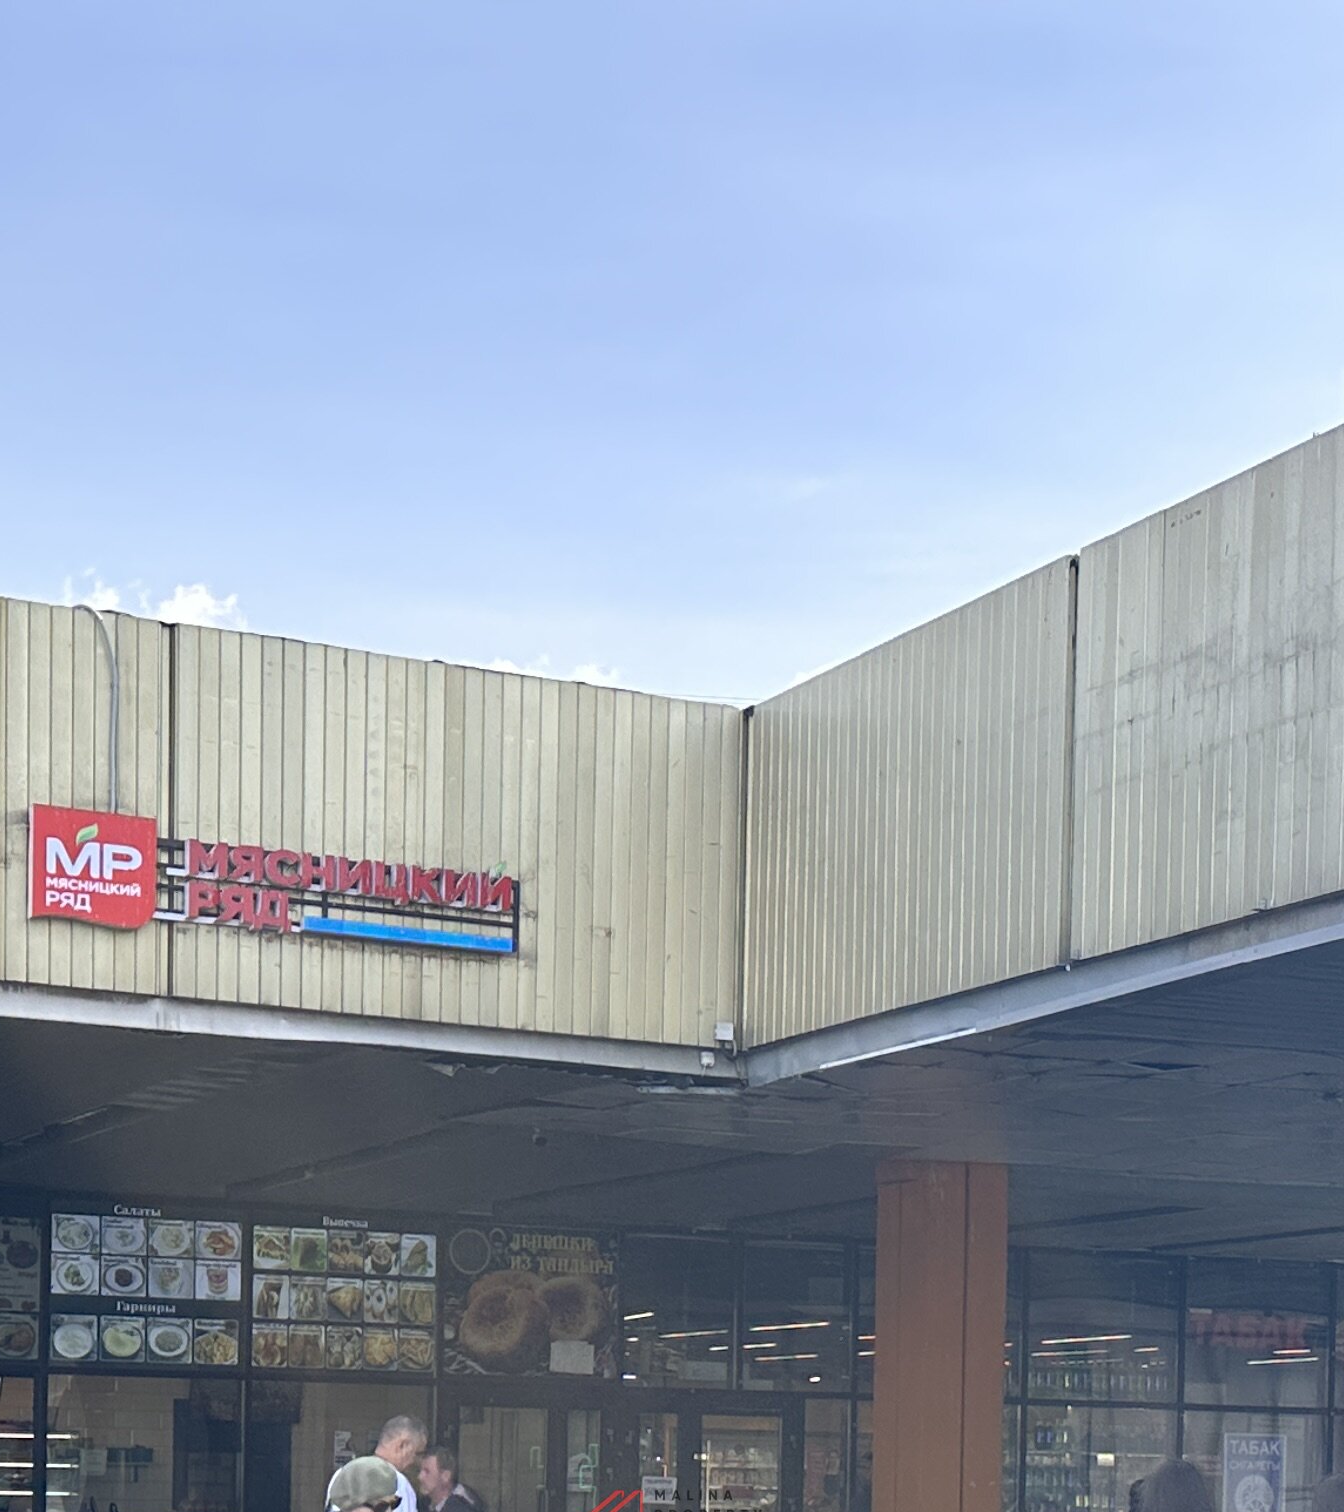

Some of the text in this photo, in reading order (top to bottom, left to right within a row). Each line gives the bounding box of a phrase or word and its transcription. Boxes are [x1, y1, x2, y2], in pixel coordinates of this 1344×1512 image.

[46, 836, 143, 880] МР
[186, 838, 513, 912] МЯСНИЦКИЙ
[46, 878, 142, 898] МЯСНИЦКИЙ
[46, 891, 92, 914] РЯД
[186, 880, 292, 933] РЯД
[113, 1204, 162, 1217] Салаты
[116, 1300, 177, 1314] Гарниры
[1230, 1439, 1281, 1457] ТАБАК
